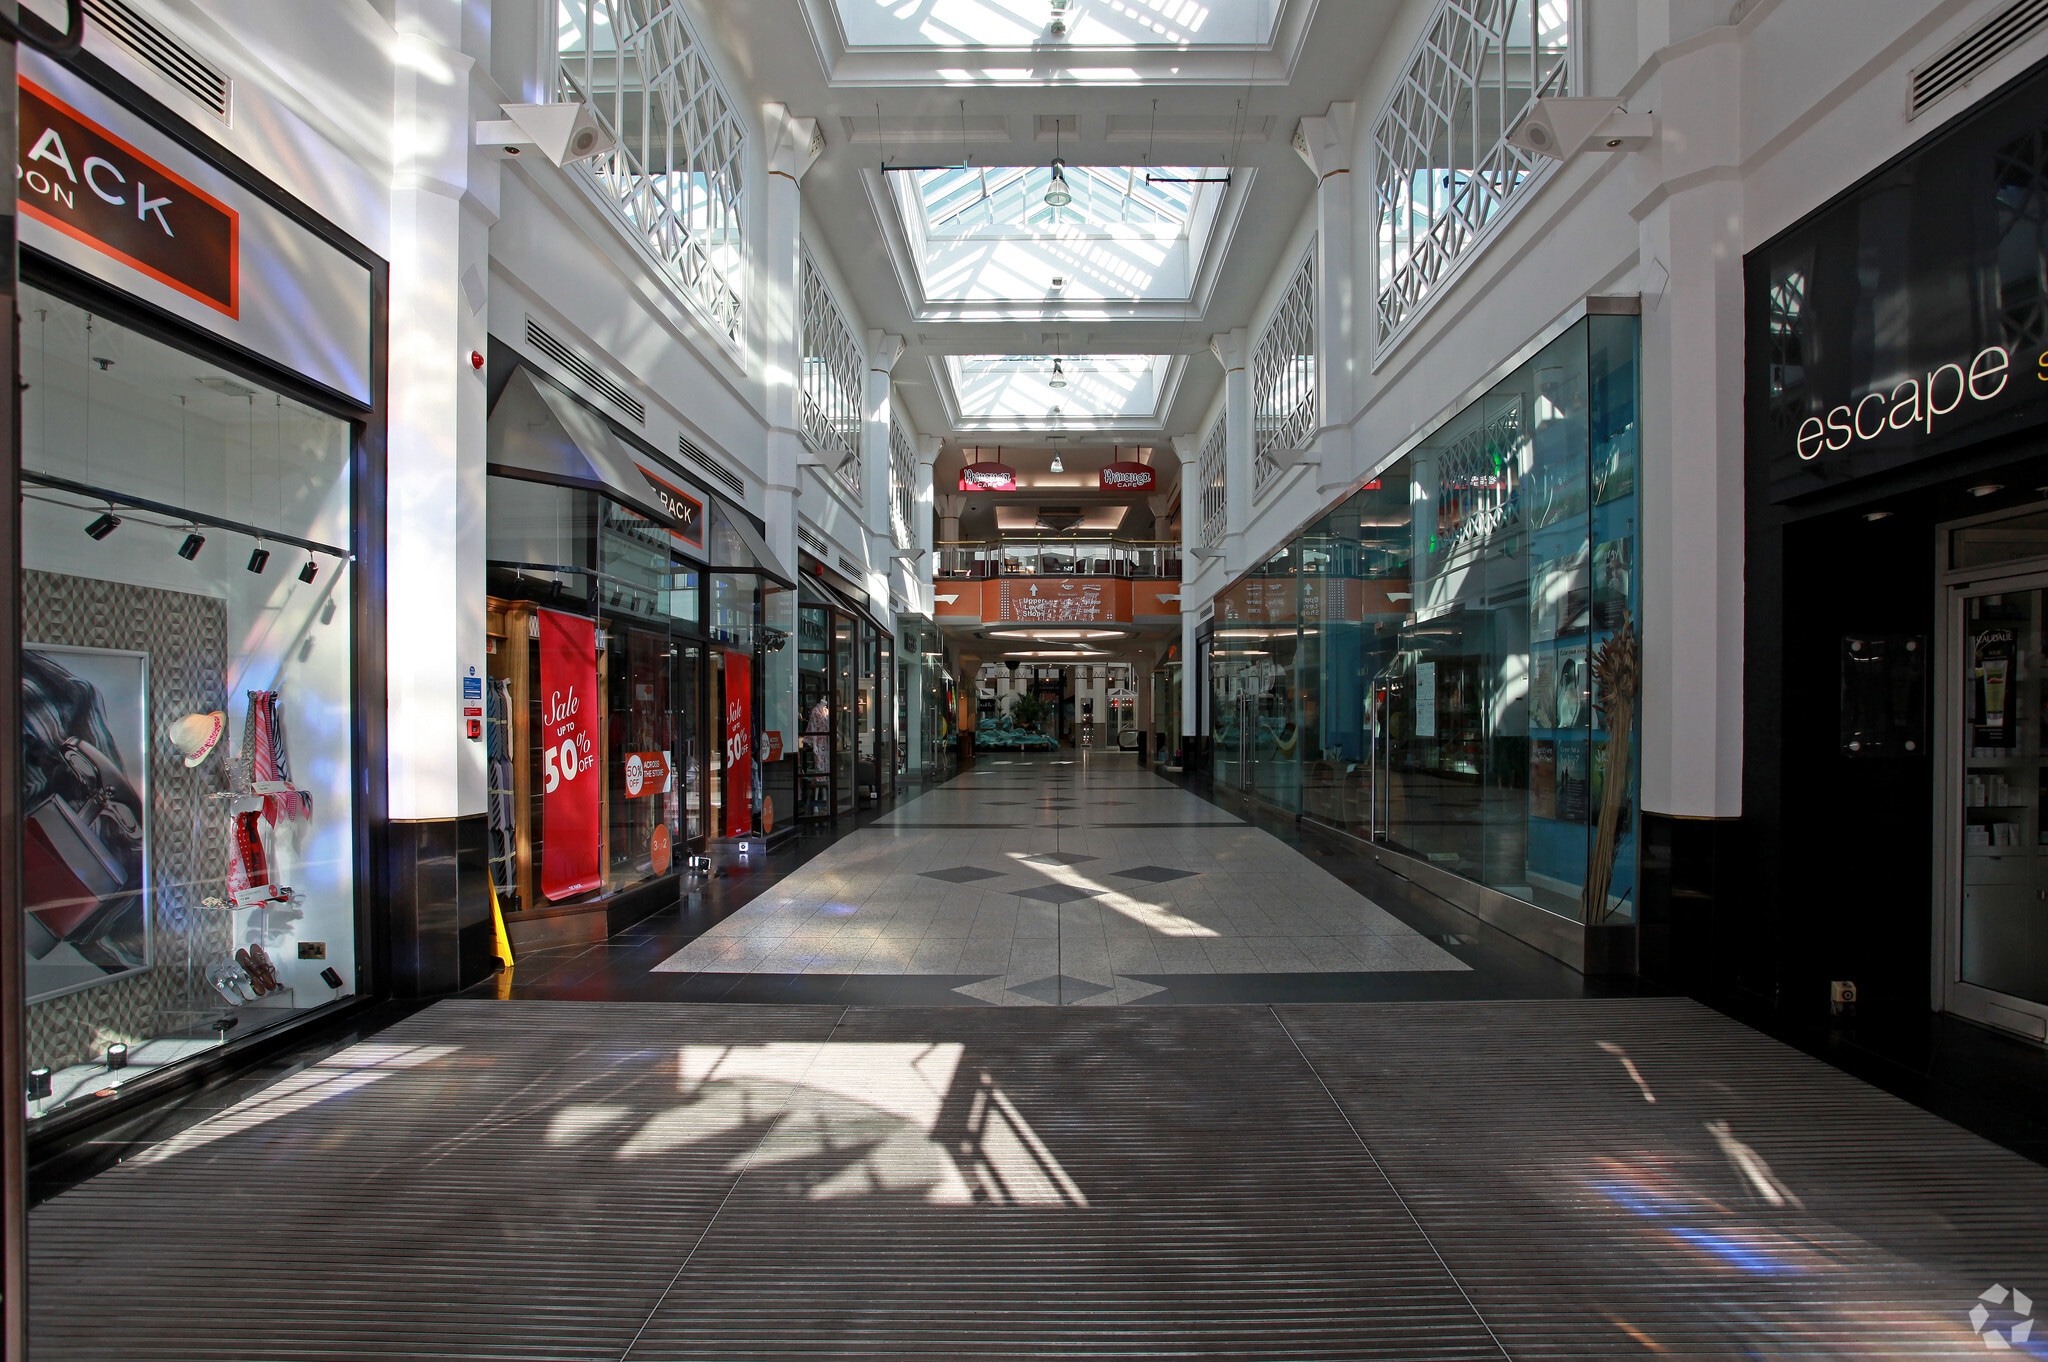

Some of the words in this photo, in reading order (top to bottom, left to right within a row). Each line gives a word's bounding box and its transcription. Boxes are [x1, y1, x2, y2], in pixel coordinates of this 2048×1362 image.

[1797, 346, 2009, 461] escape
[660, 491, 692, 524] RACK
[544, 686, 579, 726] Sale
[727, 698, 742, 725] Sale
[557, 726, 566, 736] UP
[566, 722, 575, 733] TO
[578, 755, 594, 772] OFF
[644, 760, 660, 769] ACROSS
[627, 765, 643, 778] 50%
[644, 770, 653, 778] THE
[653, 768, 664, 777] STORE
[630, 778, 640, 788] OFF
[653, 840, 658, 851] 3
[663, 838, 668, 848] 2
